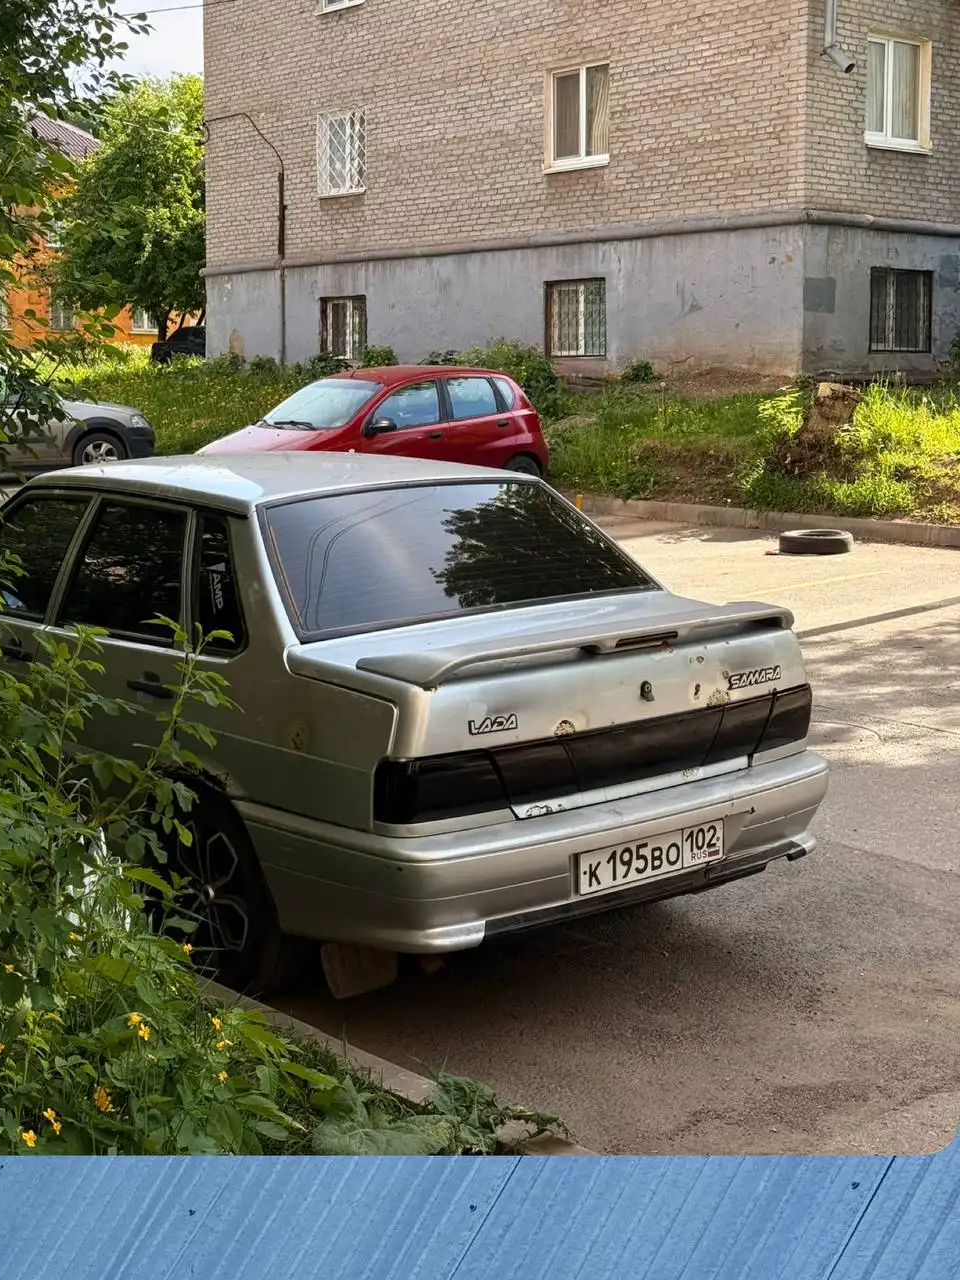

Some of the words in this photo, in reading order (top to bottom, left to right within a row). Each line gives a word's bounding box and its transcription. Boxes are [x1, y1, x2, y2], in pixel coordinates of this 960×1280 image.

[727, 665, 781, 690] SAMARA
[468, 713, 518, 735] LADA
[685, 825, 717, 853] 102
[691, 850, 708, 861] RUS
